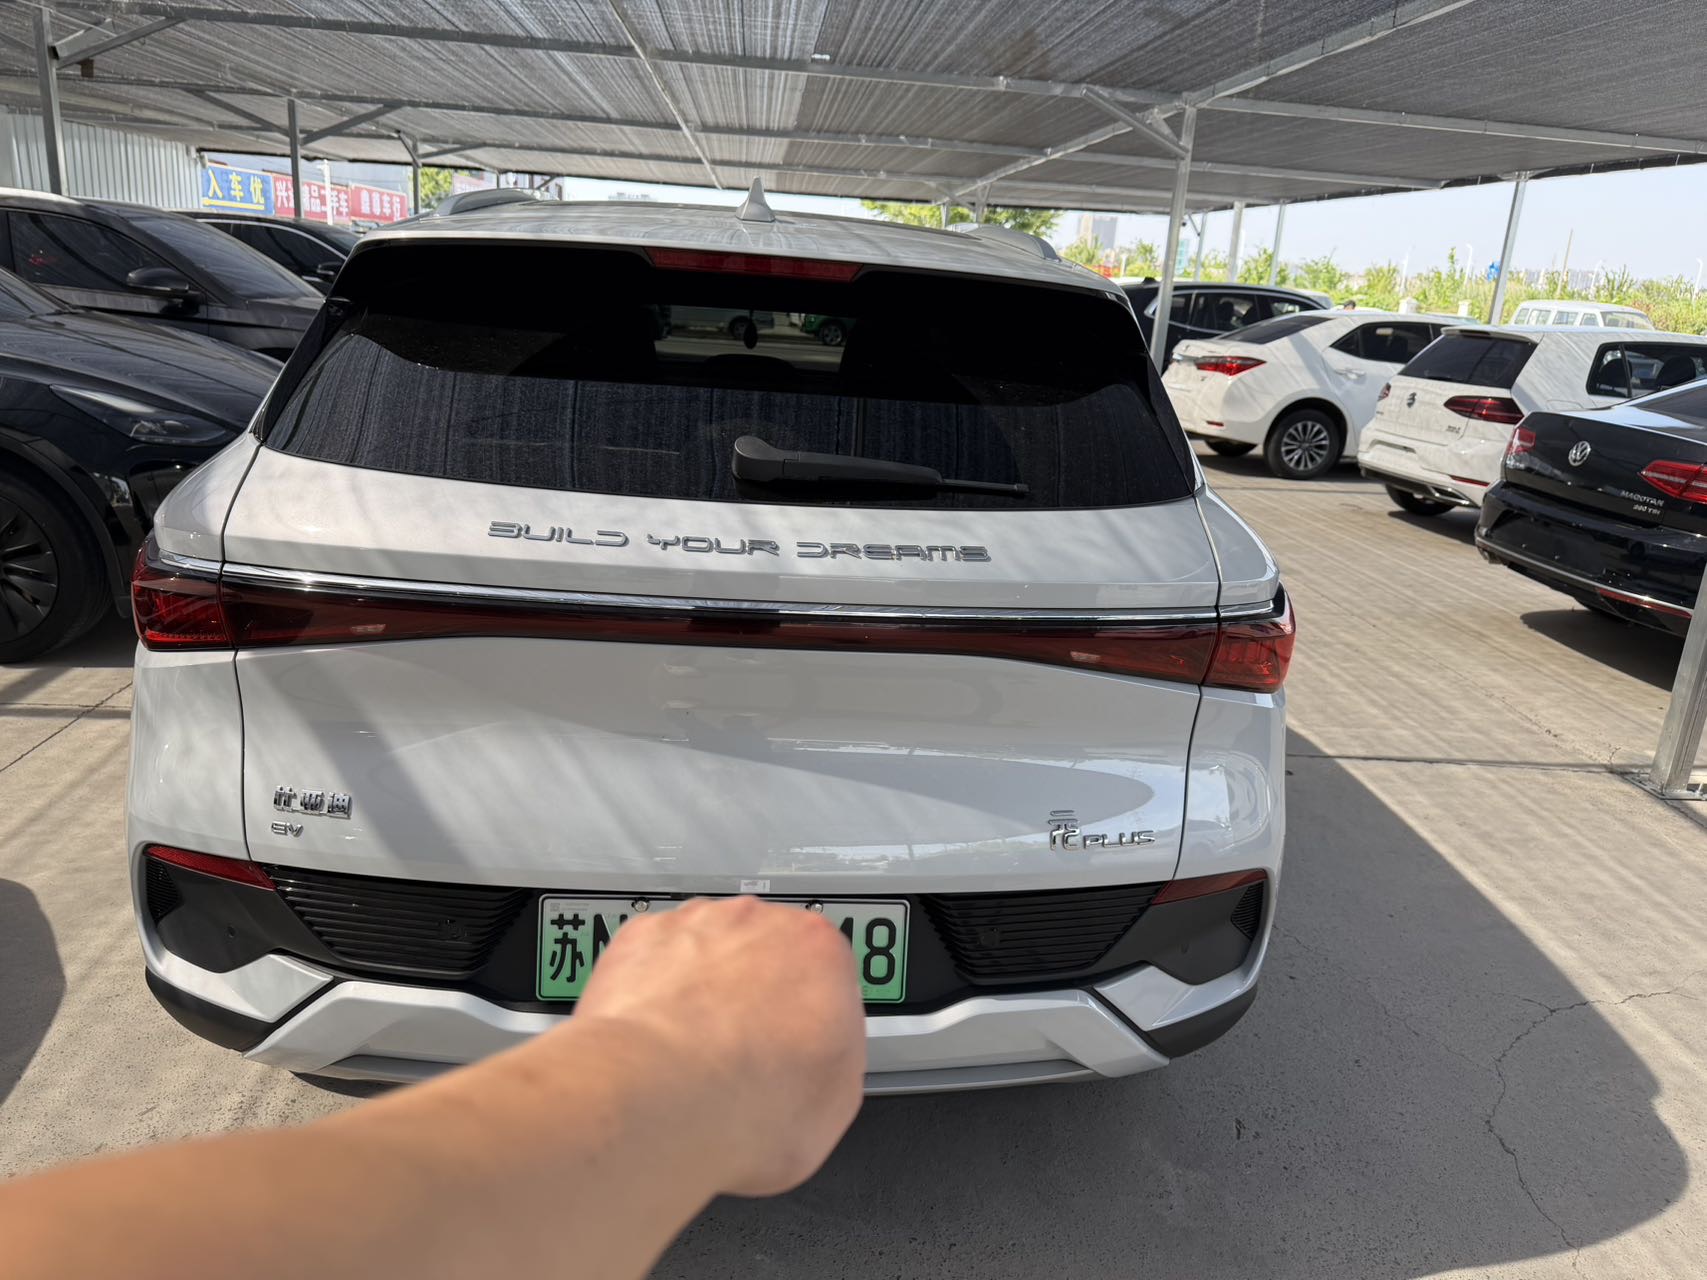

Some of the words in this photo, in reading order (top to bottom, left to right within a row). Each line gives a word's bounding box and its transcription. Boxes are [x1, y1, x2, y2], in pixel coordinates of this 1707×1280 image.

[487, 520, 630, 548] BUILD
[647, 532, 780, 558] YOUR
[796, 540, 993, 563] DREAMS
[273, 785, 353, 820] 比亚迪
[271, 820, 304, 838] EV
[1082, 829, 1156, 849] PLUS
